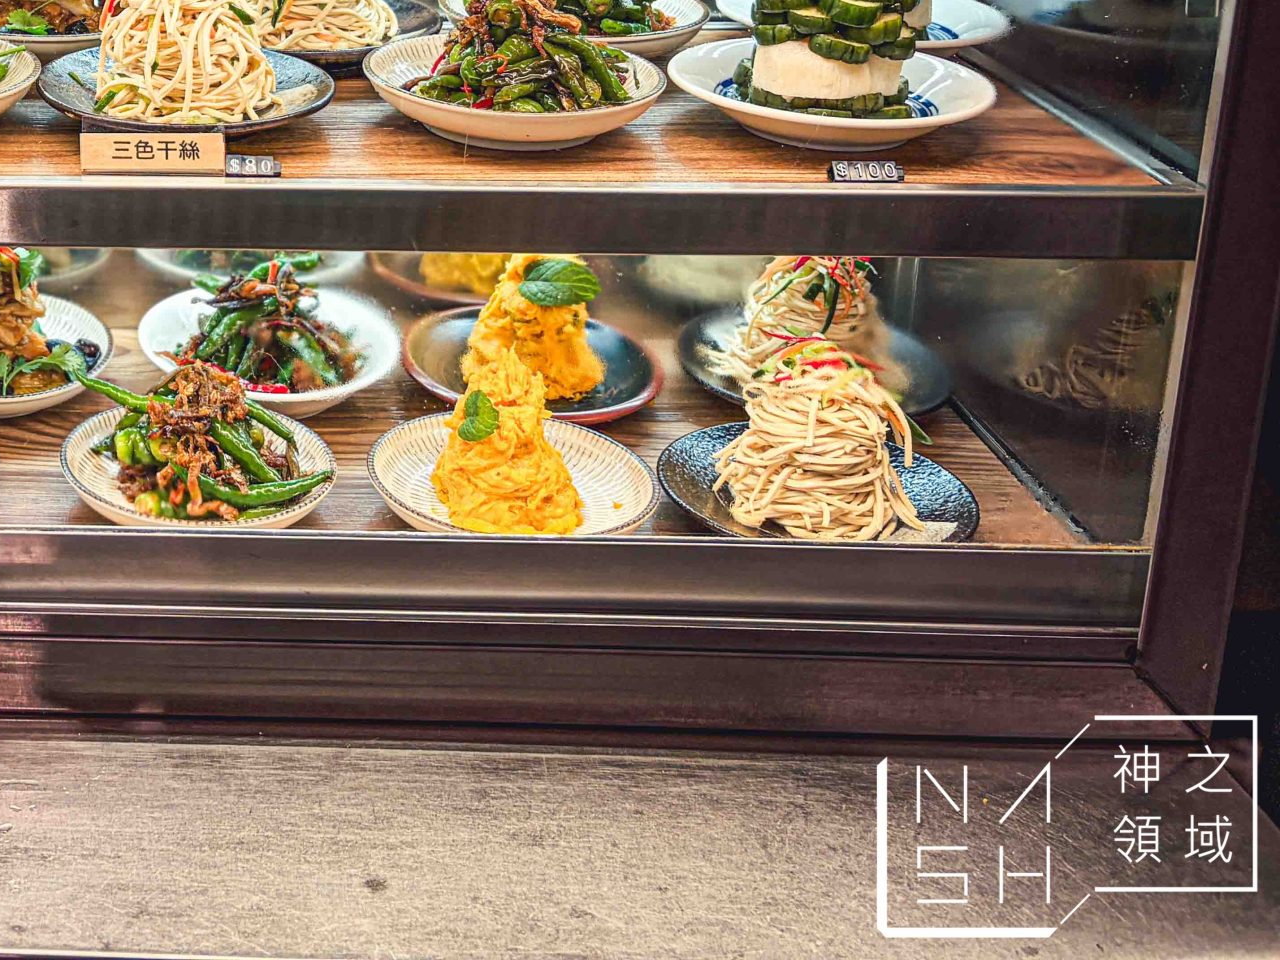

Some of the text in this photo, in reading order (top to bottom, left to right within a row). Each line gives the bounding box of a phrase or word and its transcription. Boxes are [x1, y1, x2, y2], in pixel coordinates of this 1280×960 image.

[112, 139, 200, 161] 三色干絲
[229, 158, 272, 173] $80
[836, 163, 896, 177] $100
